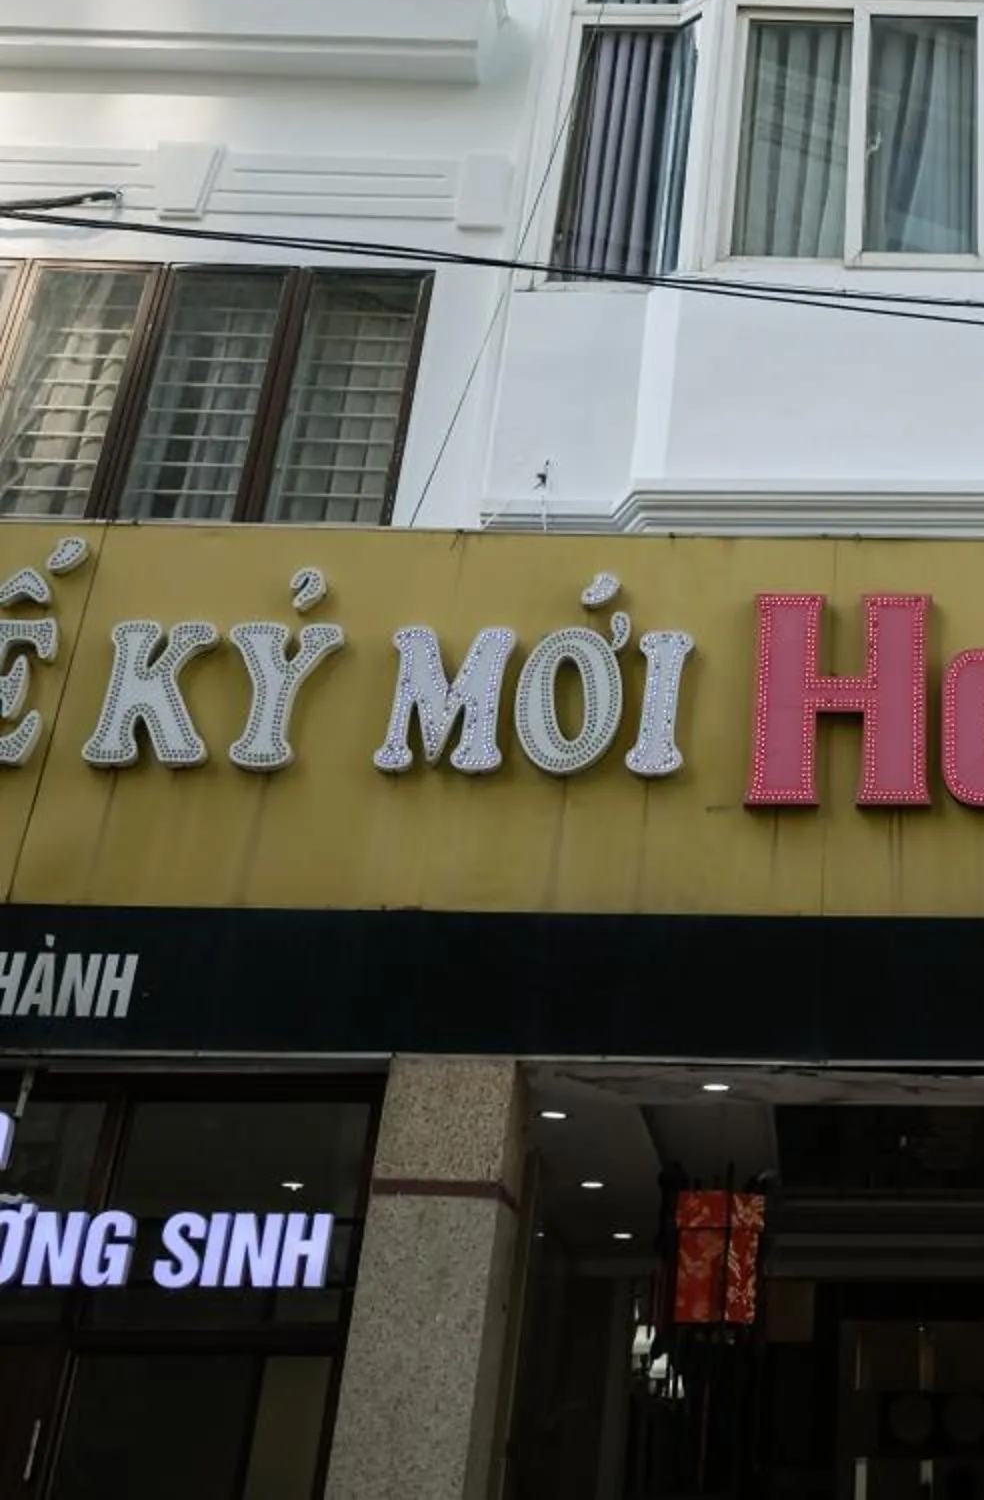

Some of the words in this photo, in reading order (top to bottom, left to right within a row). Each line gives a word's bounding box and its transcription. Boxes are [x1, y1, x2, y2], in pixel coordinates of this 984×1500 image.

[82, 566, 345, 770] KỶ
[373, 572, 695, 776] MỚI
[153, 1212, 334, 1289] SINH
